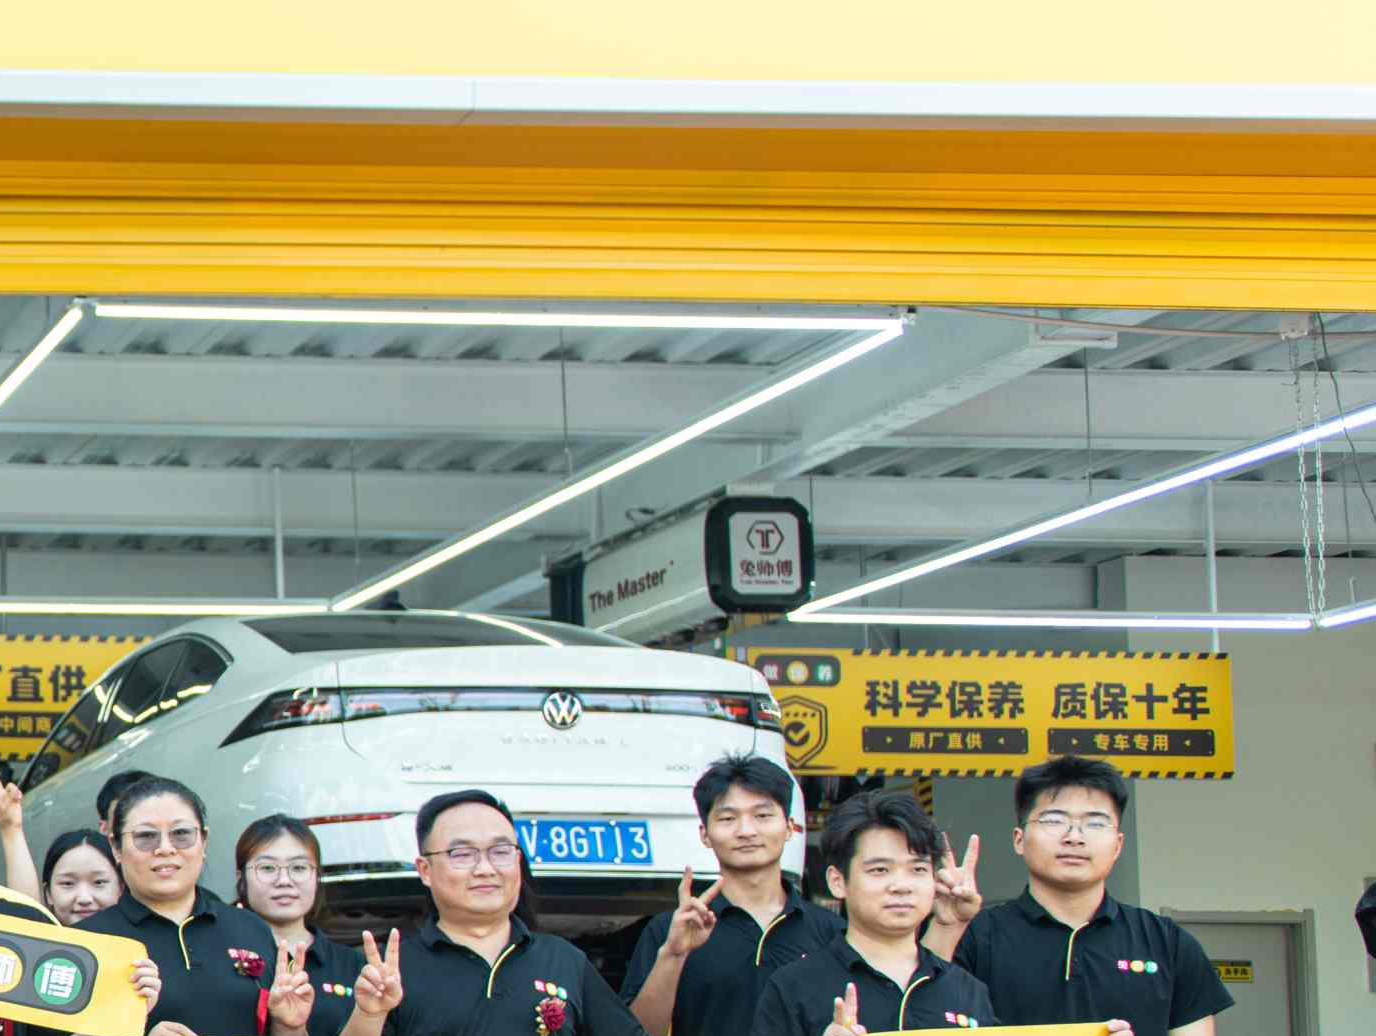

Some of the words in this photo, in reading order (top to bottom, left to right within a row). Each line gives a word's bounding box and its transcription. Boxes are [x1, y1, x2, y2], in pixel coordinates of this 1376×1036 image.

[589, 589, 613, 612] The
[617, 568, 667, 602] Master
[864, 680, 1025, 720] 科学保养
[1051, 682, 1211, 721] 质保十年
[909, 731, 984, 751] 原厂直供
[1093, 734, 1171, 753] 专车专用
